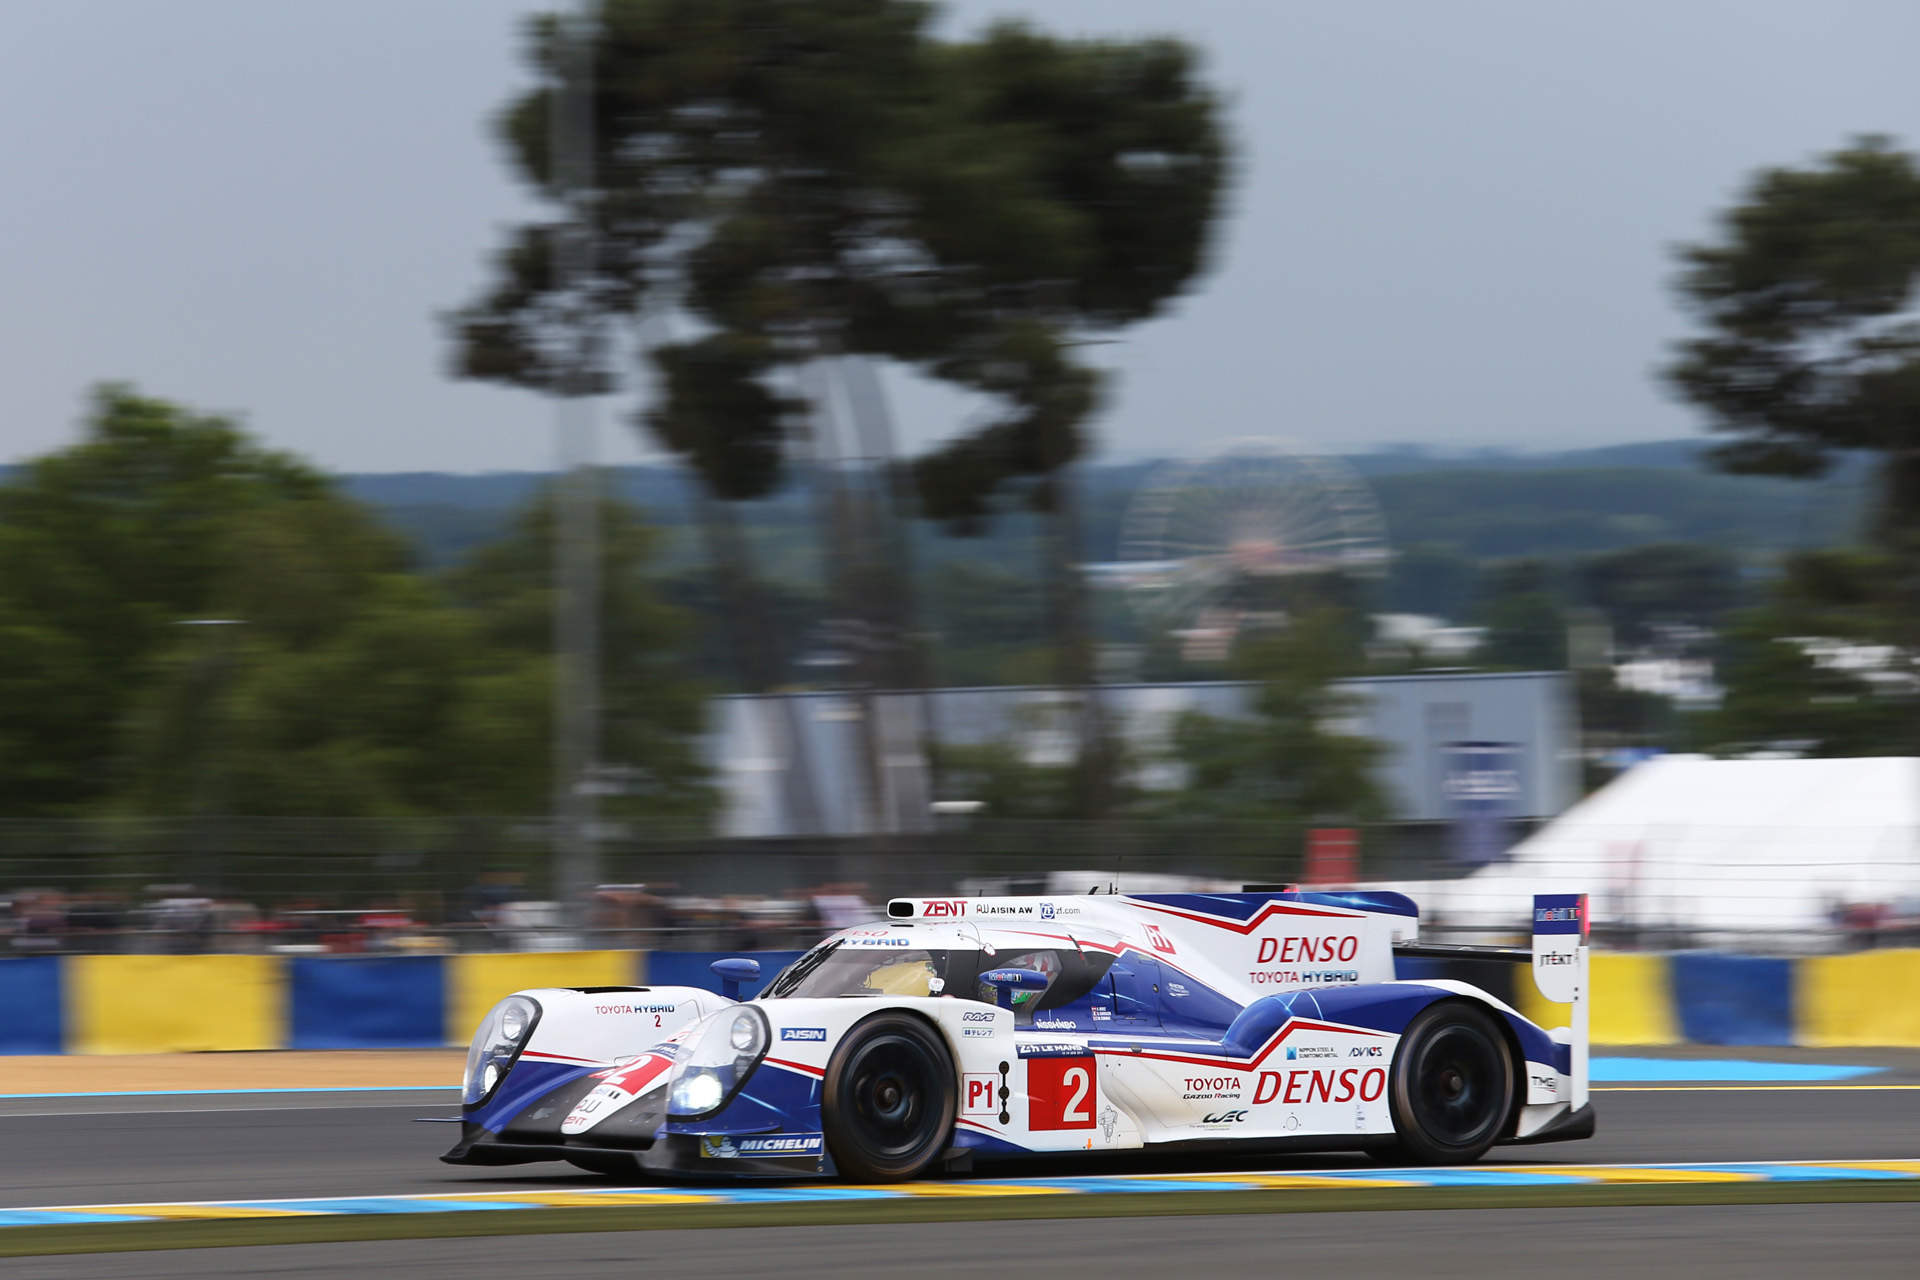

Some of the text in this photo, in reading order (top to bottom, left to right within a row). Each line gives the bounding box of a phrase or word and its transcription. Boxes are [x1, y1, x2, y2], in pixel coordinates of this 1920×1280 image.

[922, 900, 968, 917] ZENT
[990, 903, 1016, 914] AISIN
[1018, 903, 1033, 914] AW
[1056, 906, 1081, 915] zf.com
[1256, 935, 1359, 964] DENSO
[988, 972, 1013, 982] Mobil
[1249, 970, 1359, 984] TOYOTA HYBRID
[594, 1004, 675, 1015] TOYOTA HYBRID
[654, 1014, 662, 1028] 2
[962, 1011, 996, 1022] RAYS
[1035, 1018, 1077, 1030] NISSHINBO
[783, 1030, 824, 1040] AISIN
[1054, 1044, 1083, 1052] MANS
[1183, 1077, 1241, 1092] TOYOTA
[1251, 1068, 1387, 1105] DENSO
[968, 1080, 993, 1109] P1
[1062, 1066, 1090, 1123] 2
[1213, 1091, 1241, 1100] Racing
[1202, 1109, 1249, 1123] WEC
[739, 1138, 822, 1151] MICHELIN
